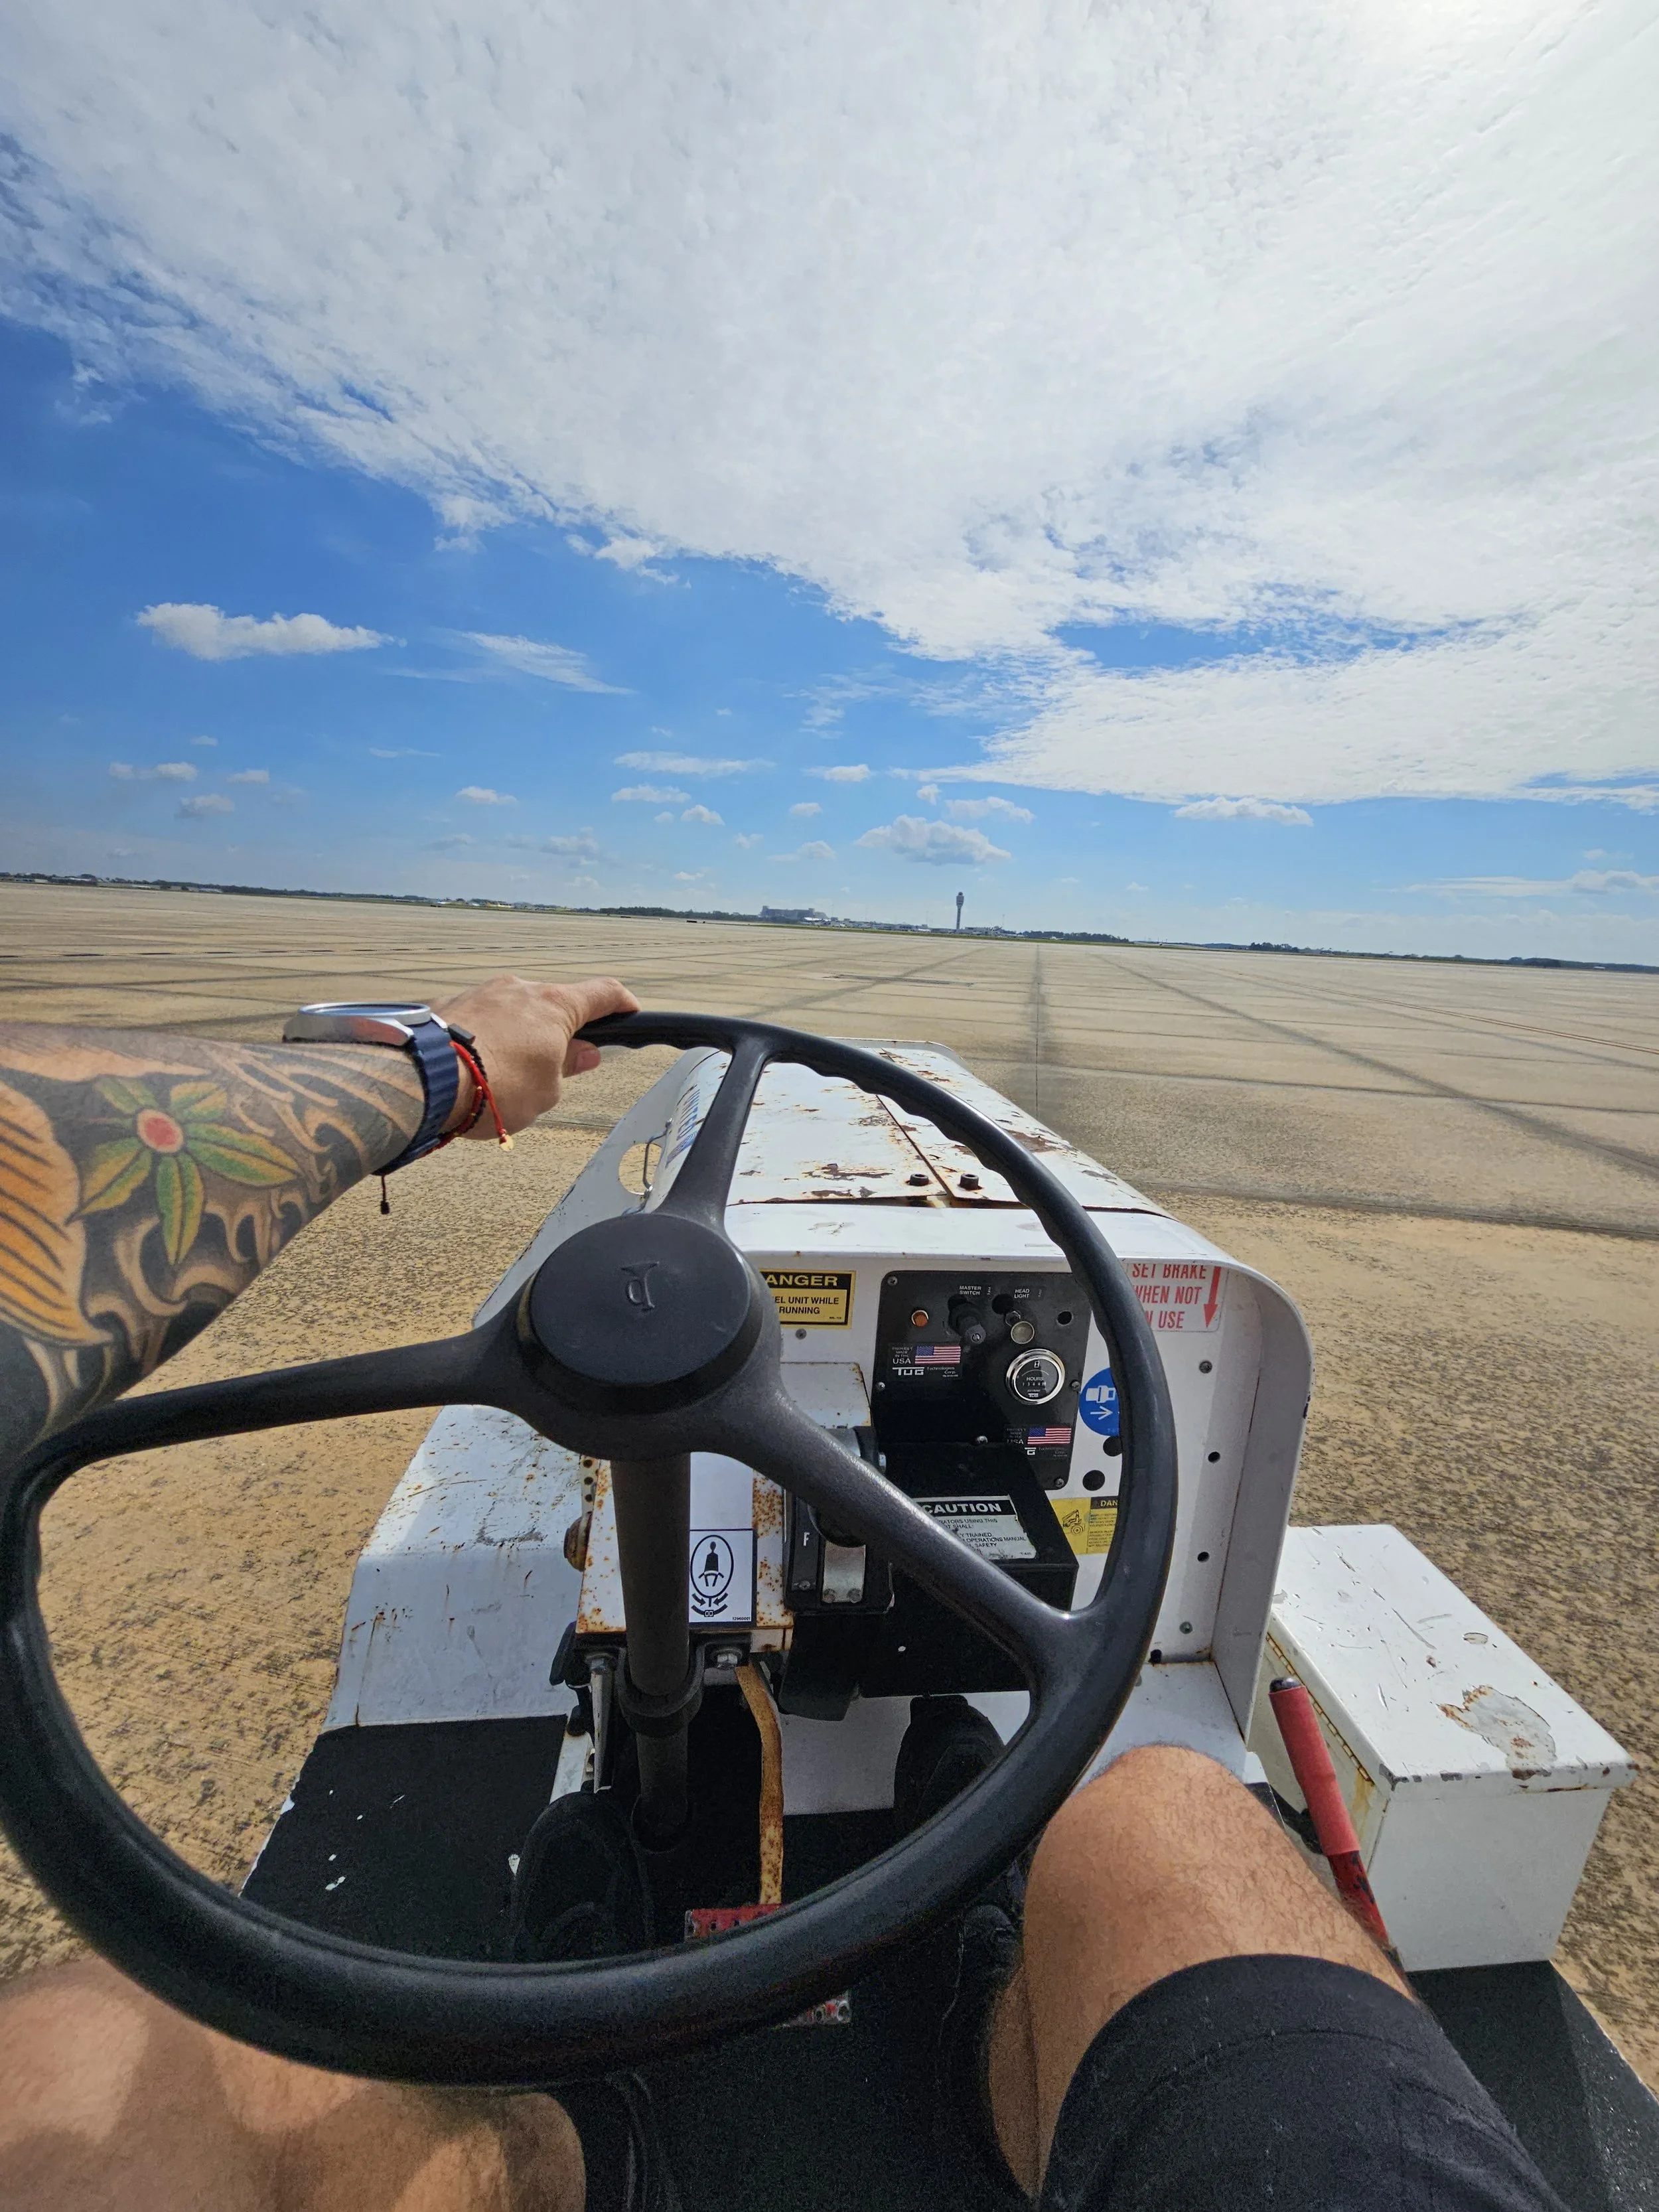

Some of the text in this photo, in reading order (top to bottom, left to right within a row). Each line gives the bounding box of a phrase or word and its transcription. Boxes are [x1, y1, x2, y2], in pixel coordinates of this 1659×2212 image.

[1132, 1263, 1207, 1280] SET BRAKE
[766, 1274, 838, 1286] ANGER
[1174, 1286, 1202, 1305] NOT
[779, 1306, 820, 1315] RUNNING
[1157, 1311, 1185, 1329] USE
[892, 1367, 925, 1376] TUG
[922, 1503, 1002, 1514] CAUTION
[803, 1532, 810, 1546] F
